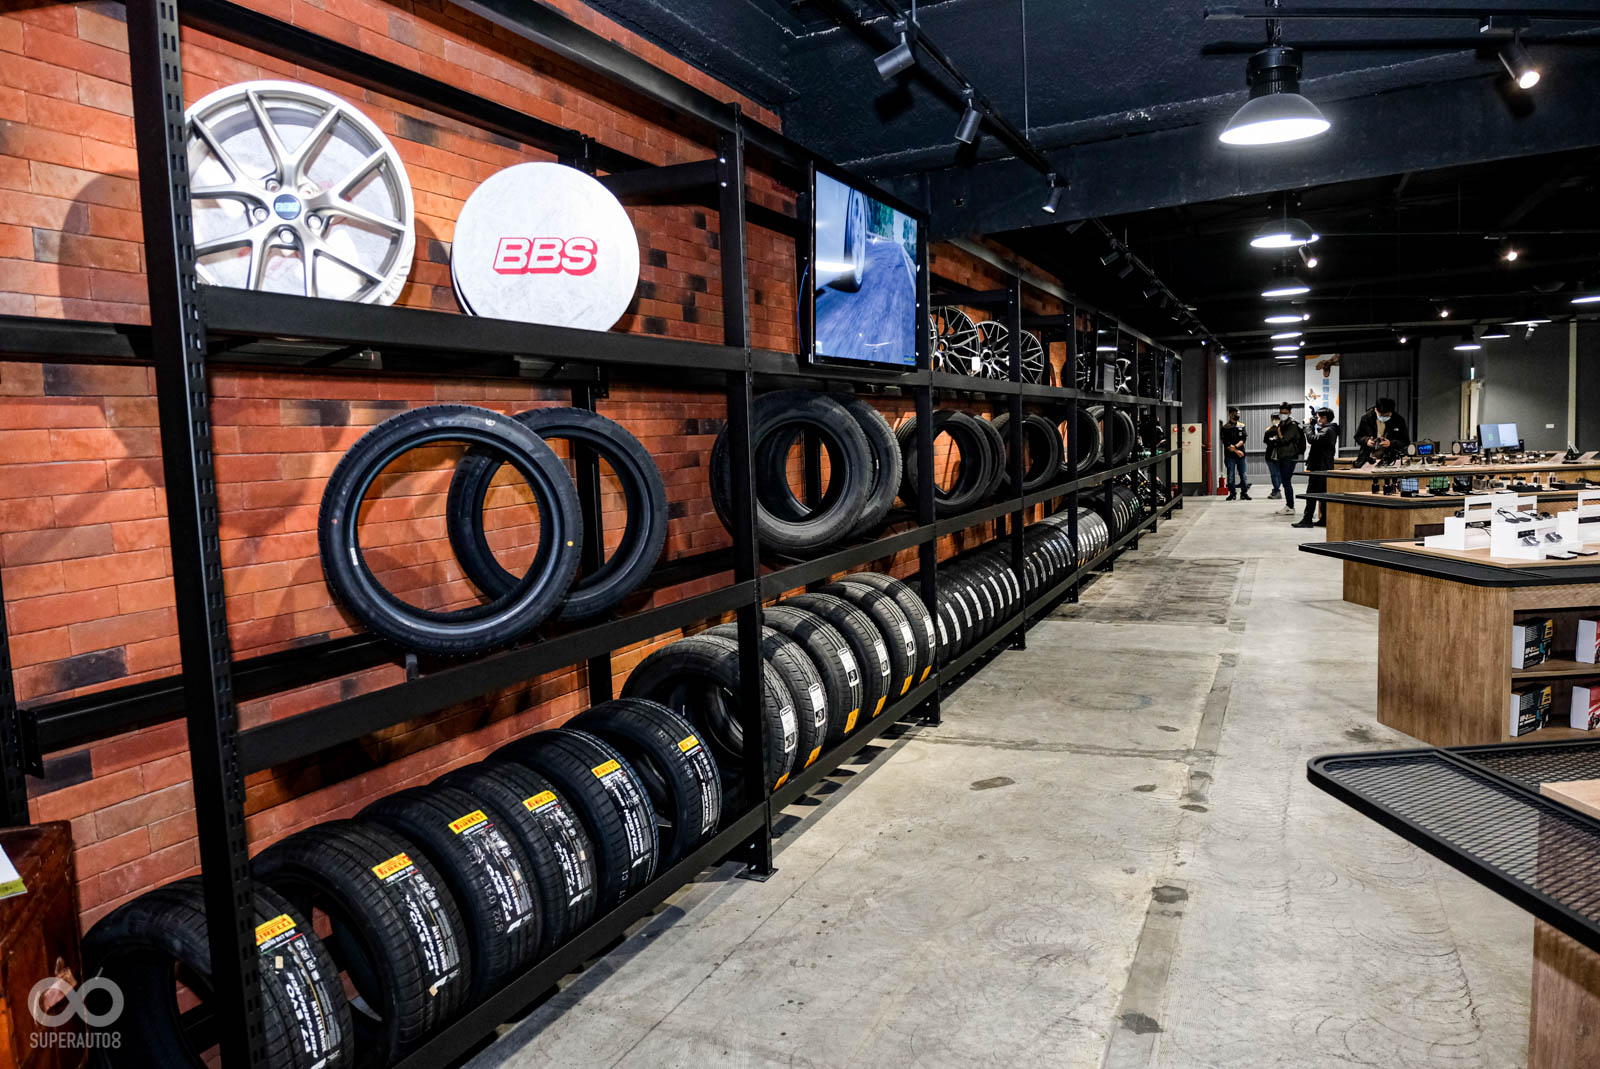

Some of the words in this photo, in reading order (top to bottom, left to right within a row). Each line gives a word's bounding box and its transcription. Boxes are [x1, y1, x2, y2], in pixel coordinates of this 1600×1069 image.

[493, 236, 598, 276] BBS
[623, 808, 638, 854] DRAGON
[378, 855, 411, 875] PIRELLI
[553, 841, 568, 870] EVO
[485, 863, 502, 894] EVO
[495, 870, 512, 910] TOURING
[409, 910, 425, 942] EVO
[410, 901, 440, 975] PERFORMANCE
[285, 983, 303, 1020] EVO
[287, 972, 318, 1058] PERFORMANCE
